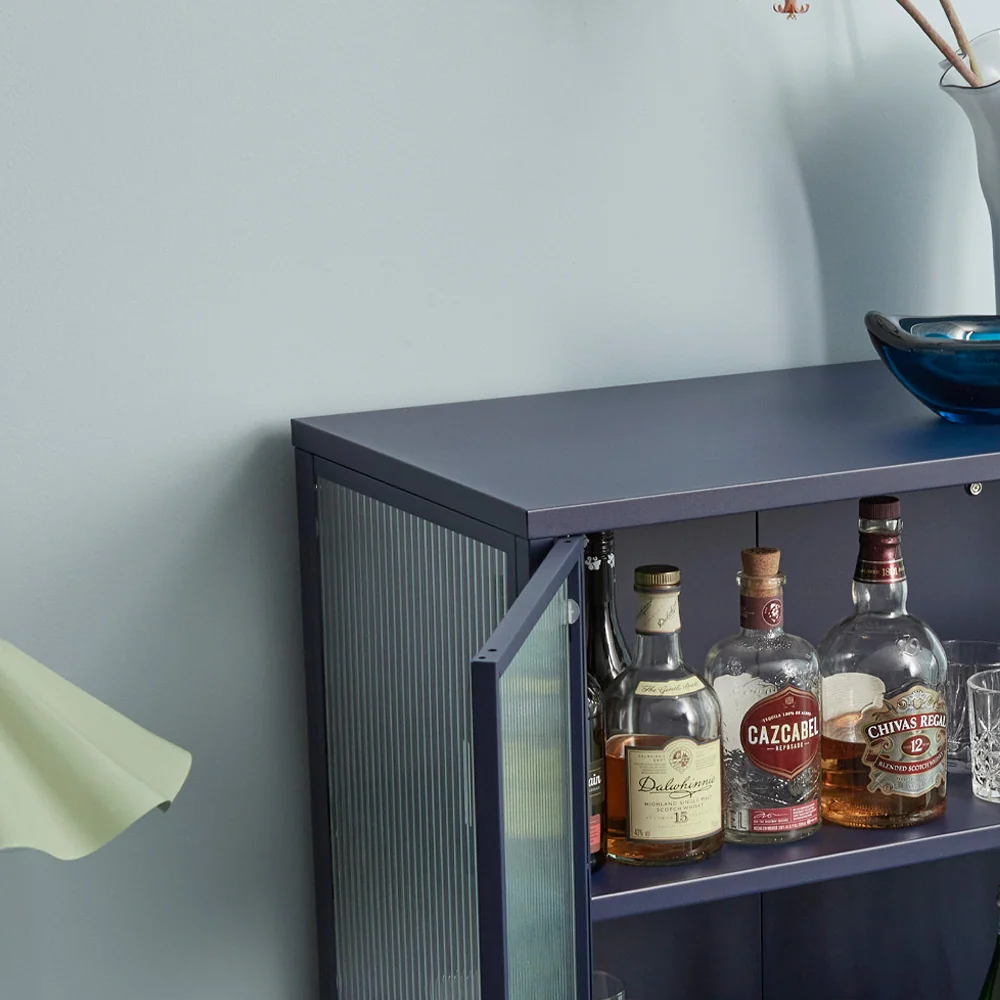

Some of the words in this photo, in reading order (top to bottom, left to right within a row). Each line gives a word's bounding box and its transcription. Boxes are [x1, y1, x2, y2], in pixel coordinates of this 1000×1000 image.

[762, 713, 781, 722] TEQUILA
[747, 716, 819, 745] CAZCABEL
[867, 716, 917, 739] CHIVAS
[920, 714, 947, 728] REGAL
[910, 738, 923, 753] 12
[878, 761, 907, 771] BLENDED
[908, 763, 929, 772] SCOTCH
[674, 811, 689, 824] 15
